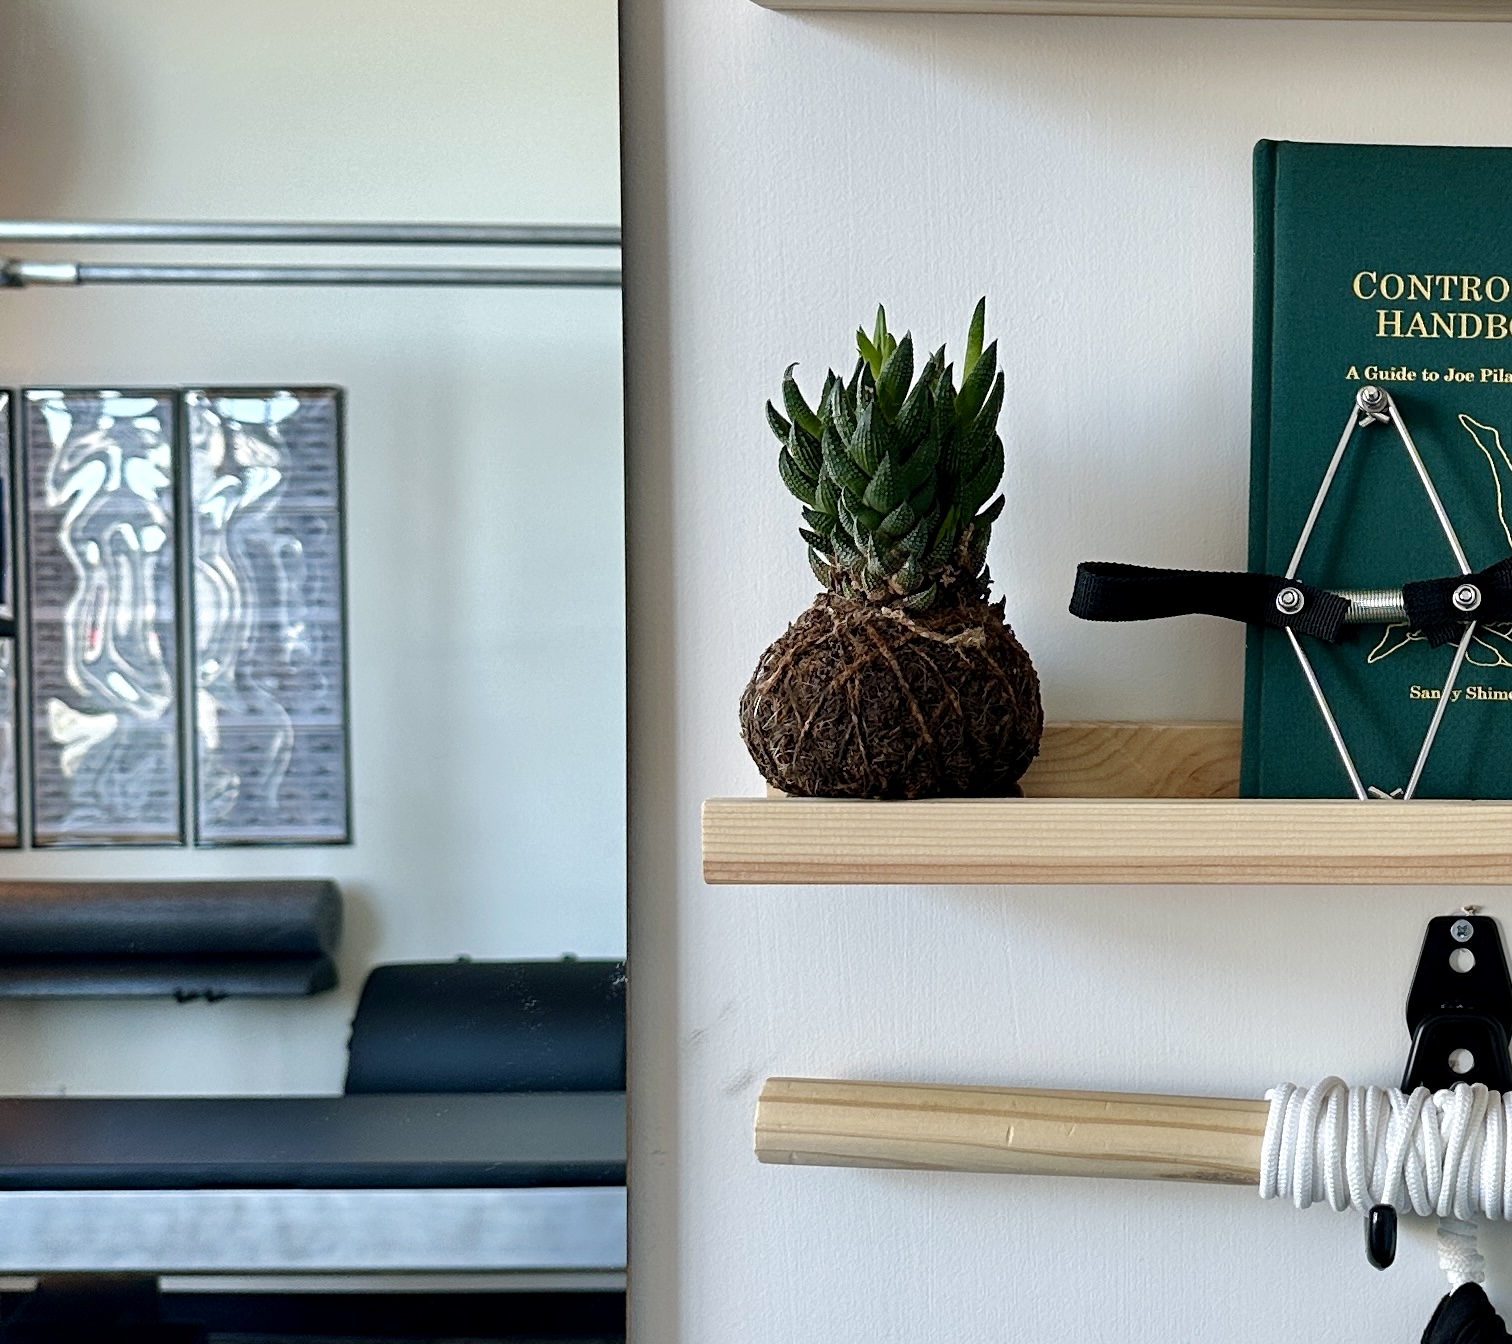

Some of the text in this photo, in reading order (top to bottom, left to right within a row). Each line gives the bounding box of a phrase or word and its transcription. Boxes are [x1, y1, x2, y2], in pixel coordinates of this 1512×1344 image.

[1345, 366, 1360, 380] A
[1364, 366, 1417, 381] Guide
[1422, 368, 1440, 382] to
[1443, 367, 1475, 382] Joe
[1409, 685, 1462, 702] Sany
